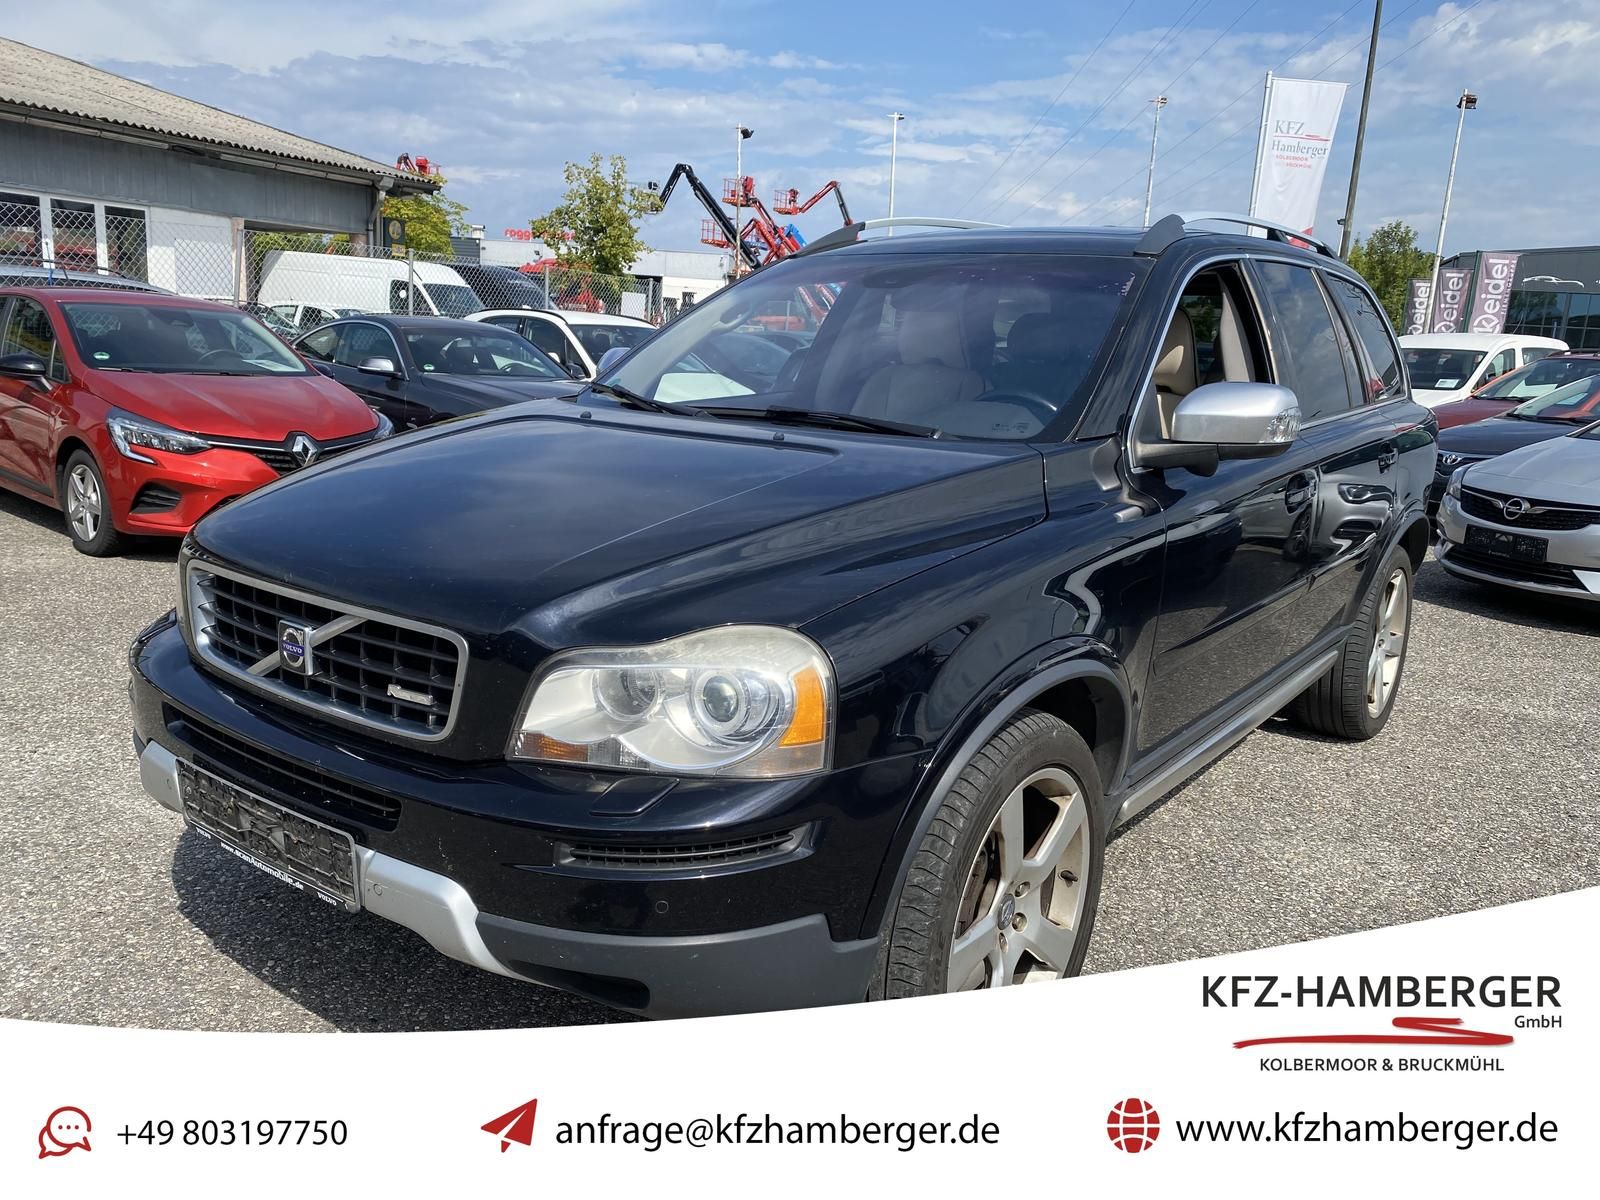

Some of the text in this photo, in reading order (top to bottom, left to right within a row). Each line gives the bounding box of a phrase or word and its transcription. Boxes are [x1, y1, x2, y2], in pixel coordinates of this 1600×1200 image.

[1275, 120, 1304, 136] KFZ
[1272, 140, 1328, 160] Hamberger
[283, 643, 303, 655] VOLVO
[317, 891, 337, 906] VOLVO
